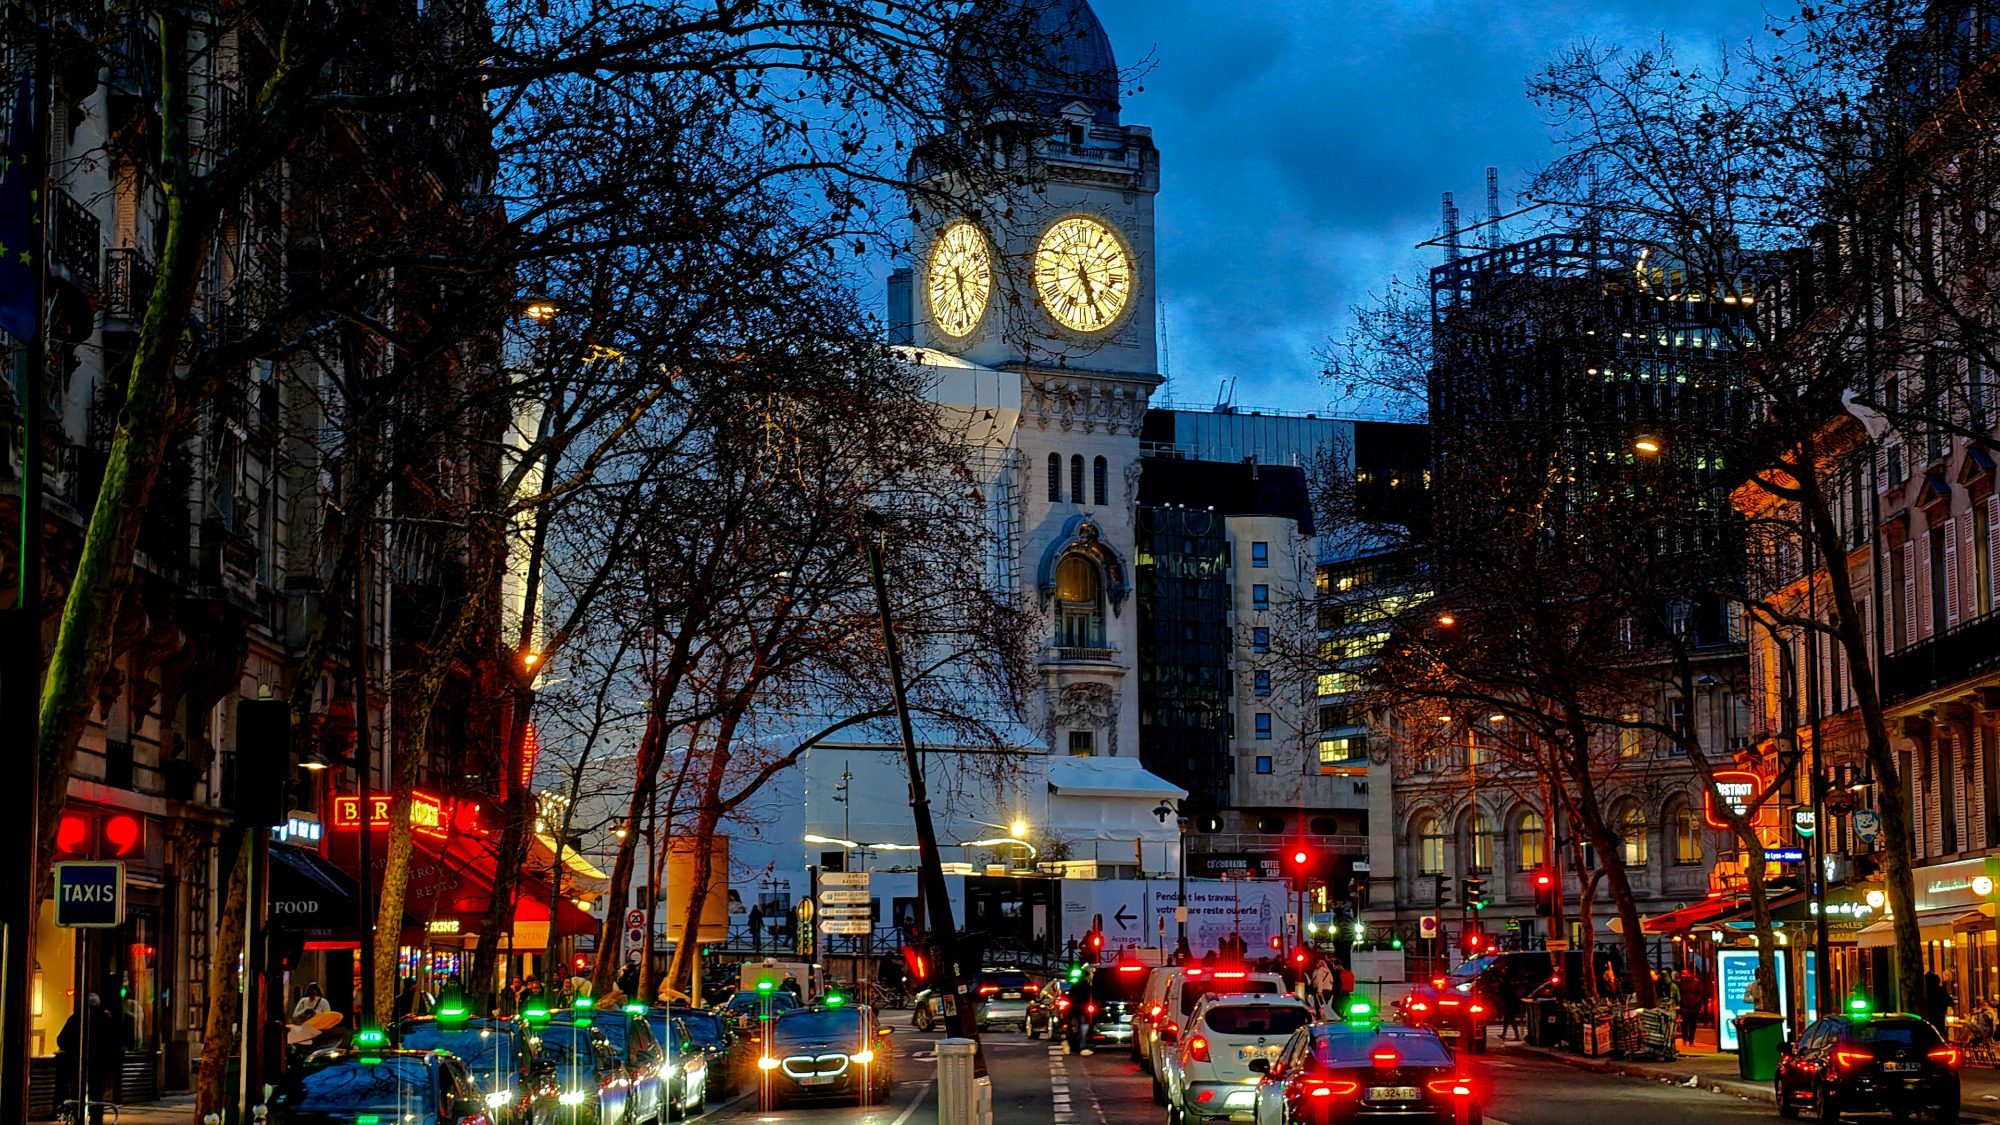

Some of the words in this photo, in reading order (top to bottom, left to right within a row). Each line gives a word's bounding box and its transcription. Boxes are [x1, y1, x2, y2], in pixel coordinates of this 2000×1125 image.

[344, 802, 389, 820] BR
[1796, 812, 1815, 823] BUS
[63, 884, 114, 902] TAXIS
[1196, 893, 1205, 901] les
[275, 902, 319, 914] FOOD
[1203, 907, 1223, 915] reste
[631, 914, 641, 924] 20
